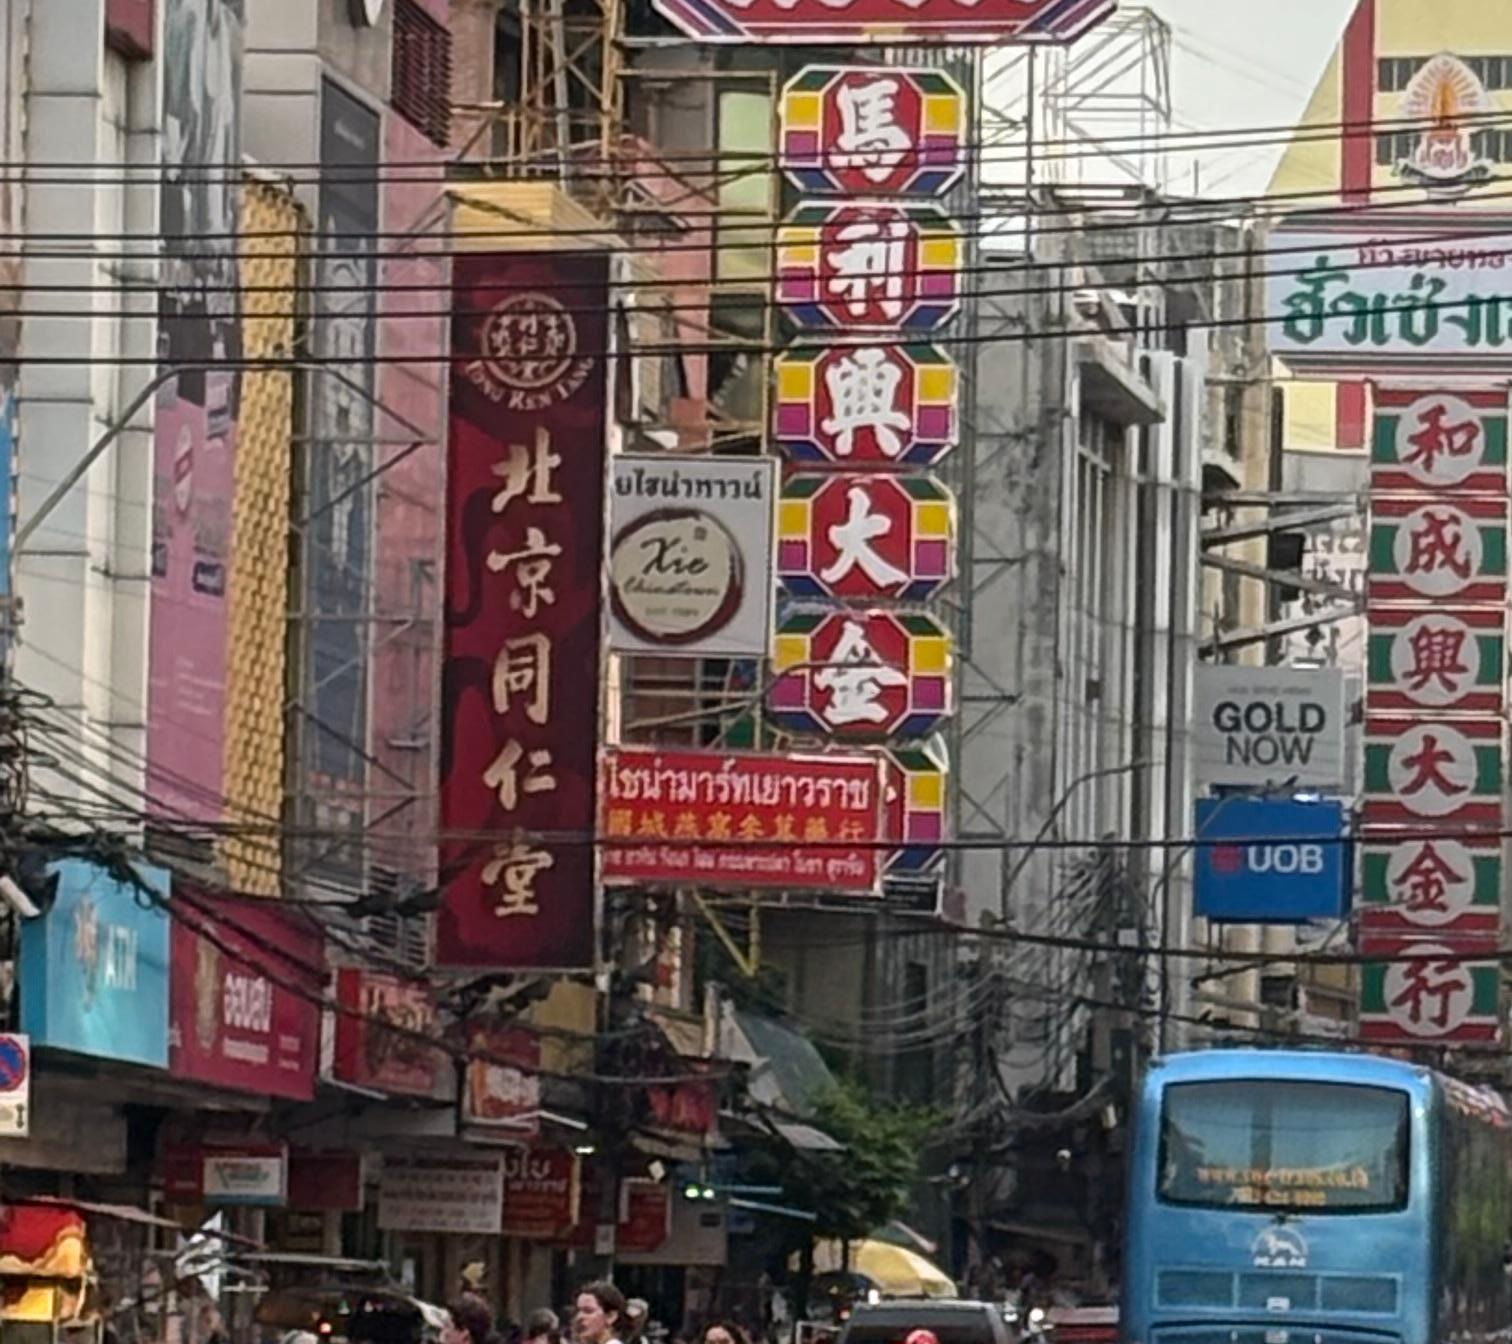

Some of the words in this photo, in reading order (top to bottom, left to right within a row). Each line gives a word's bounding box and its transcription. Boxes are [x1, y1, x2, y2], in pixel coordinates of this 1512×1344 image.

[1213, 702, 1326, 733] GOLD
[1226, 735, 1314, 765] NOW
[1247, 845, 1323, 873] UOB
